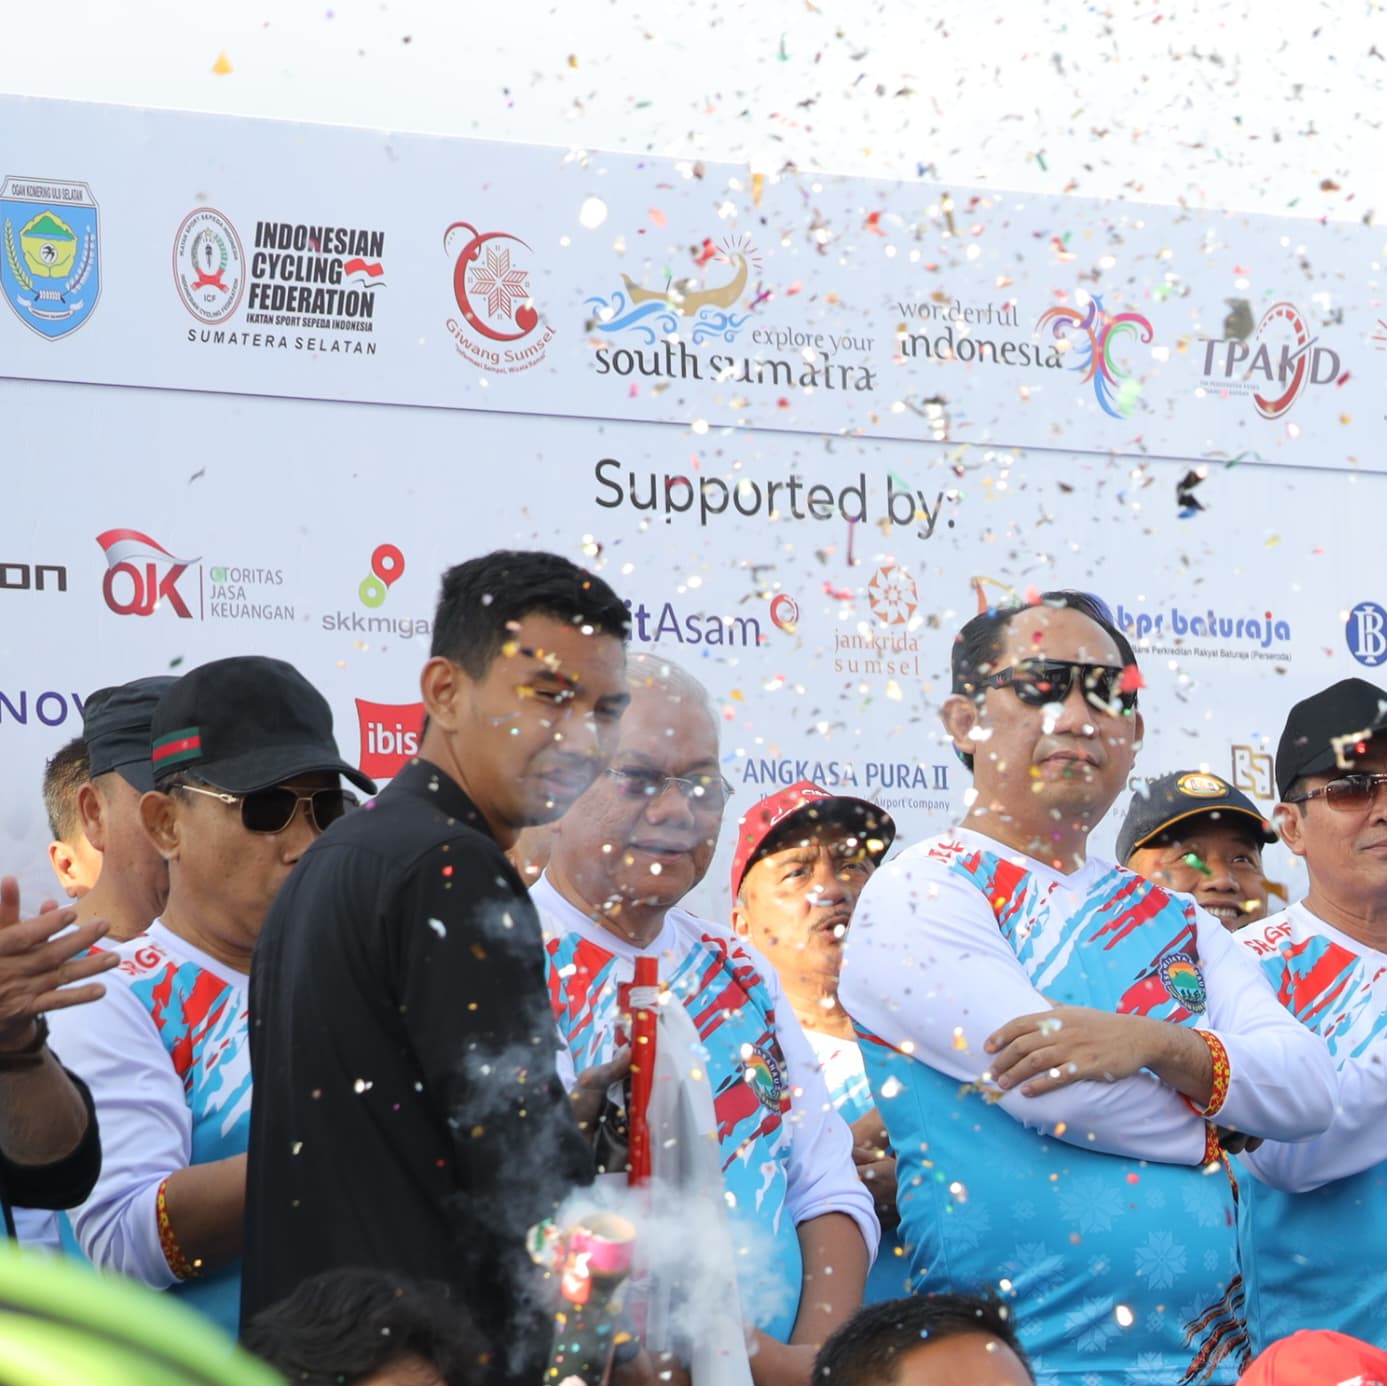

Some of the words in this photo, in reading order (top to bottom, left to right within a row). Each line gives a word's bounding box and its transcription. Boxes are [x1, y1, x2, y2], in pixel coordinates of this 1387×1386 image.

[254, 221, 384, 258] INDONESIAN
[251, 252, 344, 284] CYCLING
[248, 283, 374, 318] FEDERATION
[897, 300, 1020, 327] wonderful
[246, 313, 274, 325] IKATAN
[275, 315, 301, 327] SPORT
[302, 317, 331, 329] SEPEDA
[332, 319, 373, 332] INDONESIA
[188, 329, 288, 349] SUMATERA
[295, 337, 377, 355] SELATAN
[446, 318, 500, 364] Giwang
[504, 325, 557, 362] Sumsel
[752, 327, 824, 351] explore
[830, 333, 875, 355] your
[900, 327, 1063, 369] indonesia
[596, 340, 703, 380] south
[710, 353, 877, 391] sumatra
[1198, 337, 1341, 385] TPAKD
[595, 458, 866, 525] Supported
[887, 474, 955, 540] by:
[209, 566, 284, 586] OTORITAS
[210, 585, 246, 601] JASA
[211, 603, 295, 621] KEUANGAN
[834, 628, 919, 655] jamkrida
[1172, 608, 1291, 648] baturaja
[834, 657, 920, 676] sumsel
[368, 724, 418, 755] ibis
[743, 758, 858, 788] ANGKASA
[866, 763, 928, 790] PURA
[932, 765, 949, 791] II
[908, 798, 949, 812] Company
